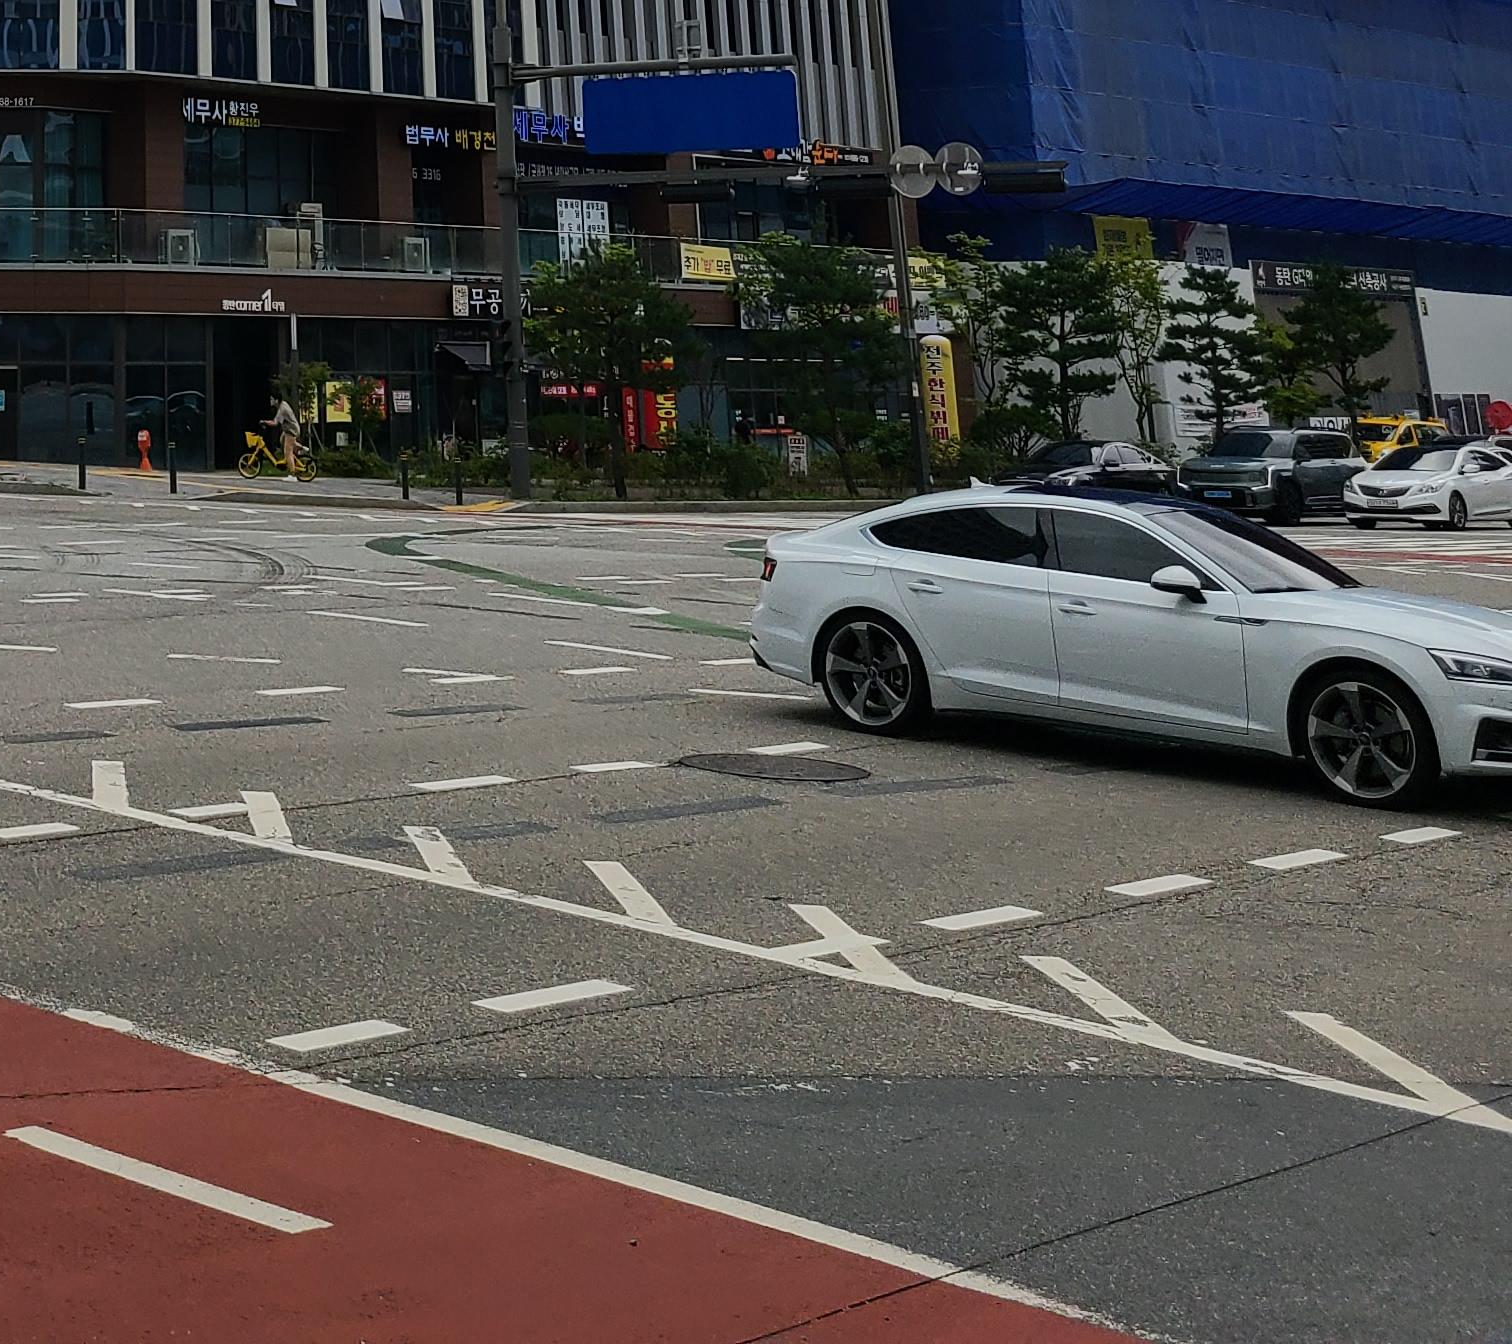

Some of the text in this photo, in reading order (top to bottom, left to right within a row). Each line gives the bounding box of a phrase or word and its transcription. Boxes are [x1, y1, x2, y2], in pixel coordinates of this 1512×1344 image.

[182, 97, 228, 125] 세무사
[405, 124, 449, 148] 법무사
[716, 259, 732, 275] 무료
